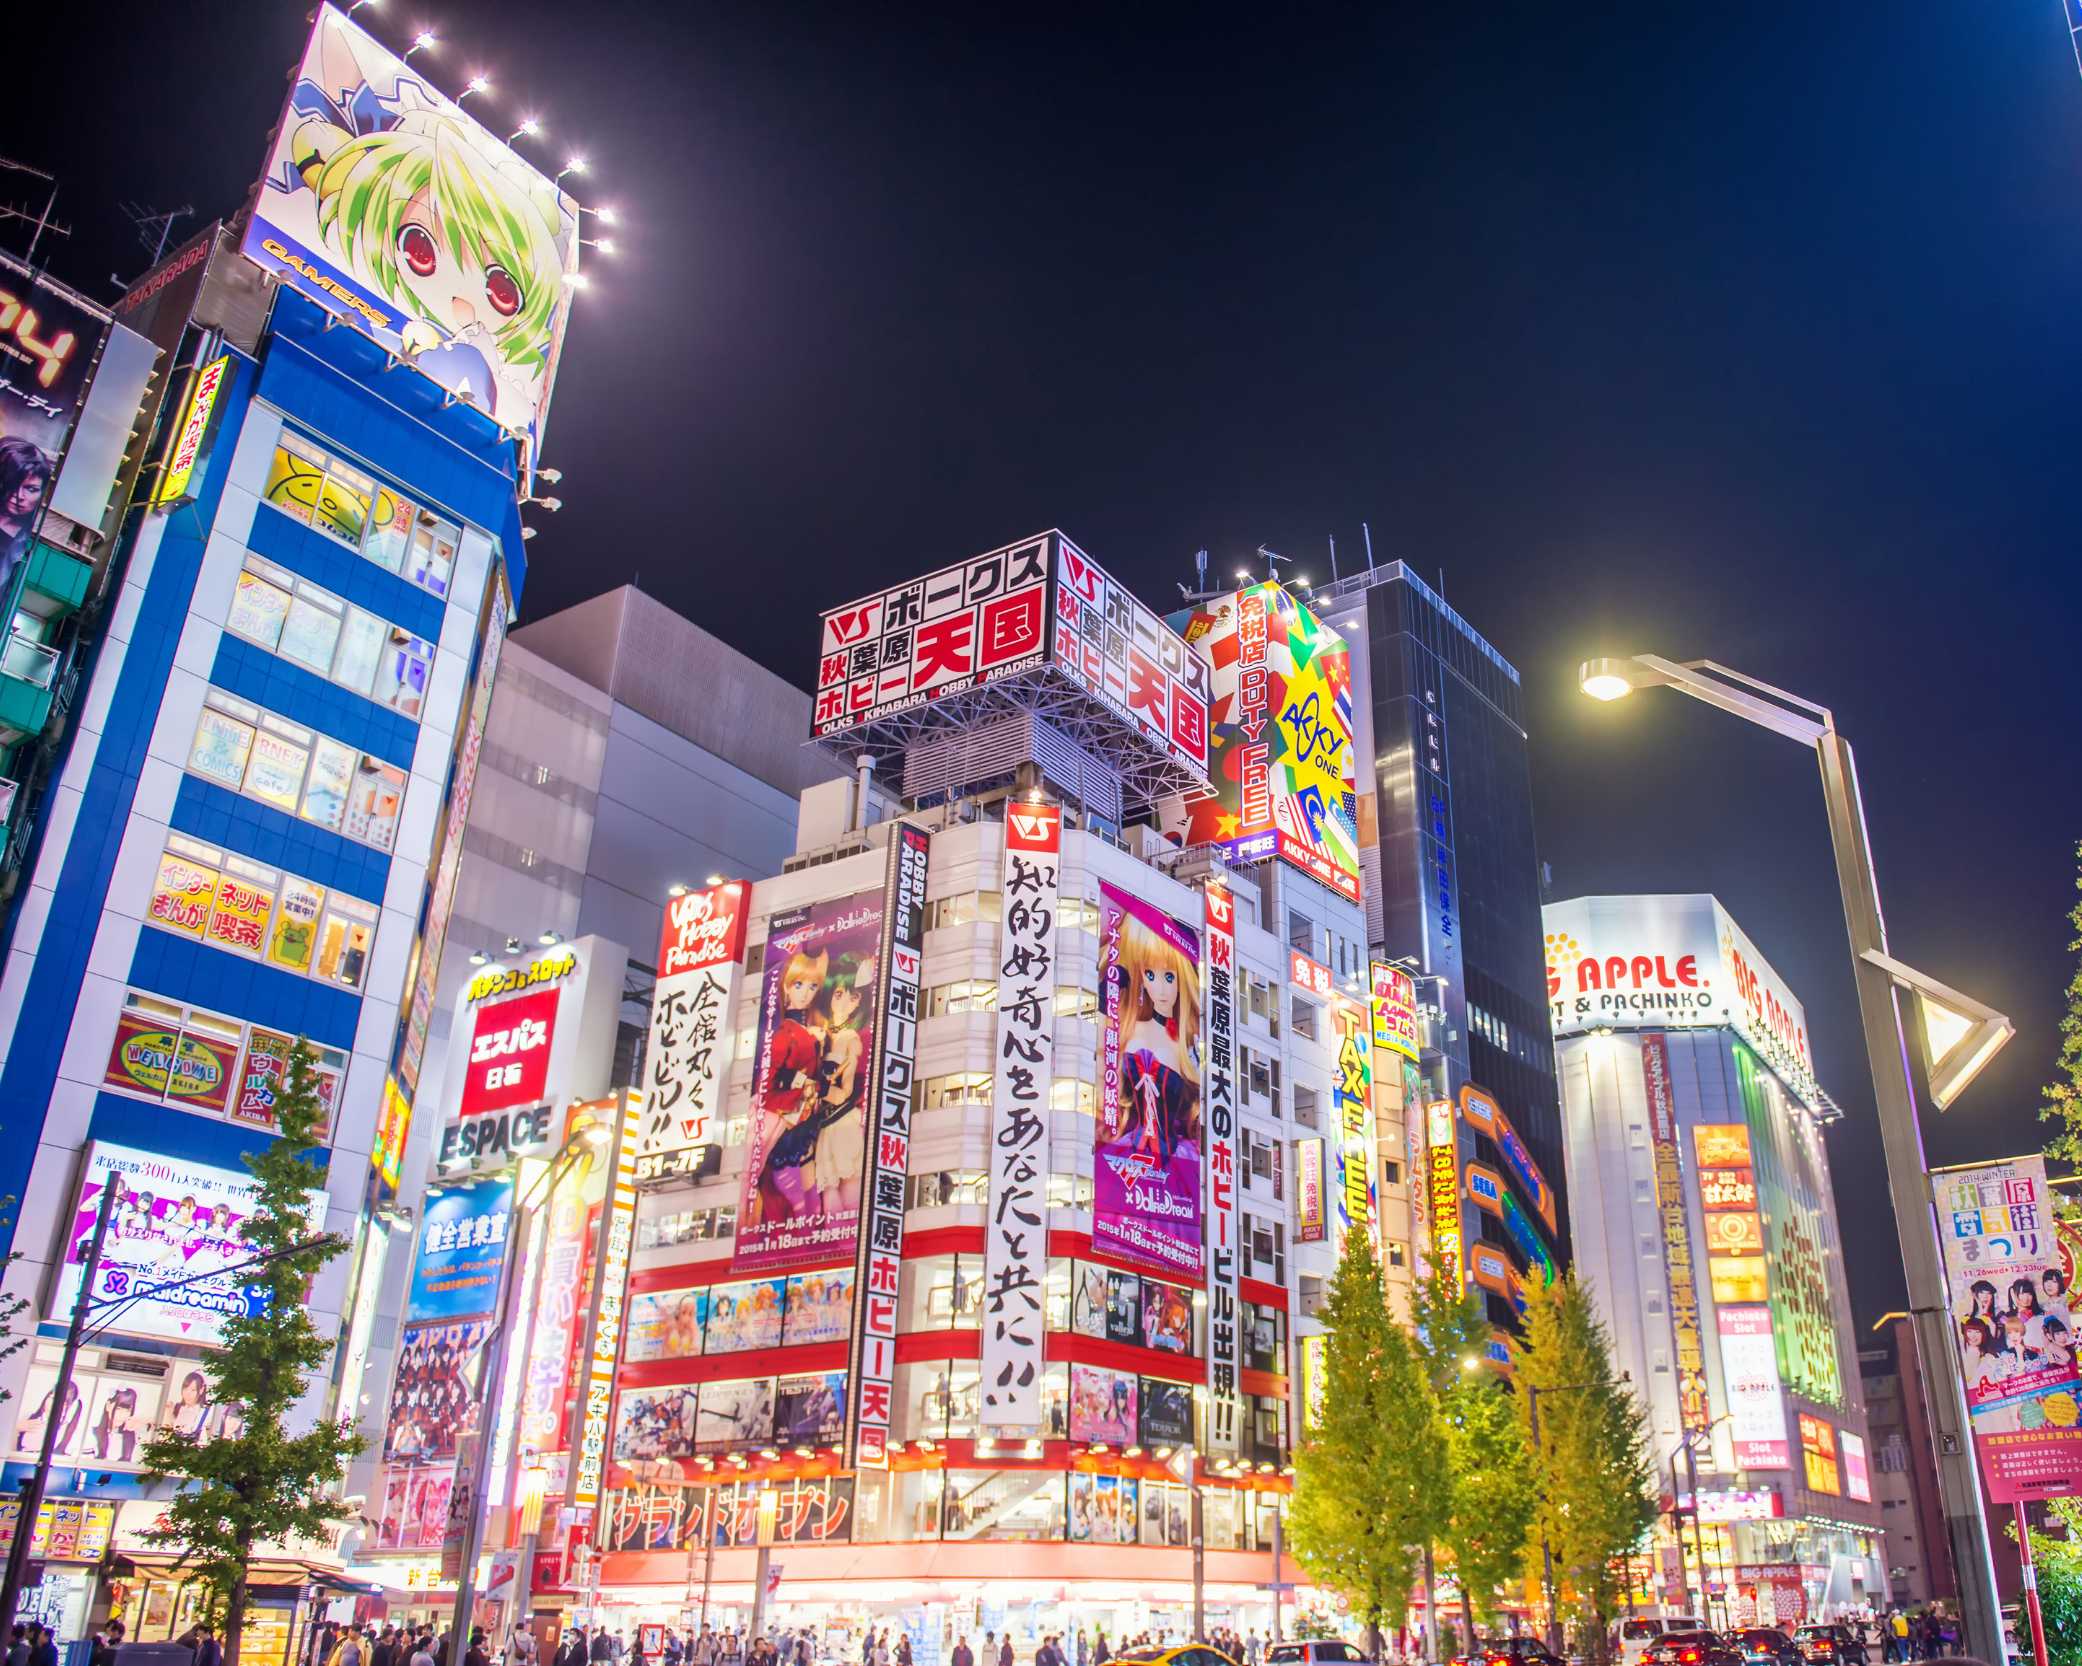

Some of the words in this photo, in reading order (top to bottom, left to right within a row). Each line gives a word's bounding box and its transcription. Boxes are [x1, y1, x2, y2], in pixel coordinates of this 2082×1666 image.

[262, 239, 392, 328] GAMERS
[886, 541, 1047, 632] ボークス
[913, 586, 1042, 690] 天国
[1058, 586, 1126, 664] 秋葉原
[1107, 591, 1208, 698] ボークス
[1239, 593, 1268, 668] 免税店
[821, 630, 911, 686] 秋葉原
[1057, 626, 1124, 691] ホビー
[816, 669, 908, 724] ホビー
[857, 692, 928, 723] AKIHABARA
[929, 677, 976, 700] HOBBY
[977, 653, 1044, 683] PARADISE
[1129, 649, 1206, 762] 天国
[1239, 669, 1268, 742] DUTY
[1240, 742, 1270, 828] FREE
[1315, 755, 1339, 780] ONE
[162, 862, 213, 894] インター
[219, 882, 269, 915] ネット
[894, 830, 915, 942] PARADISE
[911, 834, 929, 911] HOBBY
[151, 894, 206, 927] まんが
[212, 913, 263, 949] 喫茶
[680, 913, 734, 948] Hobby
[666, 941, 729, 974] Paradise
[1296, 958, 1333, 994] 免税
[1575, 997, 1591, 1013] &
[1600, 992, 1713, 1011] PACHINKO
[127, 1044, 218, 1084] WELCOME
[471, 1018, 547, 1063] エスパス
[1338, 1007, 1364, 1101] TAX
[439, 1104, 553, 1163] ESPACE
[987, 854, 1058, 1407] 知的好奇心をあなたと共に!!
[1210, 932, 1236, 1441] 秋葉原最大のホビービル出現!!
[1340, 1101, 1369, 1227] FREE
[1471, 1173, 1497, 1200] SEGA
[1950, 1177, 2036, 1211] 秋葉原
[1953, 1204, 2040, 1238] 電気街
[1961, 1233, 2039, 1262] まつり
[134, 1279, 250, 1319] maidreamin
[1719, 1311, 1769, 1323] Pachinko
[1734, 1323, 1757, 1334] Slot
[1736, 1453, 1787, 1467] Pachinko
[1748, 1441, 1772, 1453] Slot
[613, 1484, 850, 1547] グランドオプン
